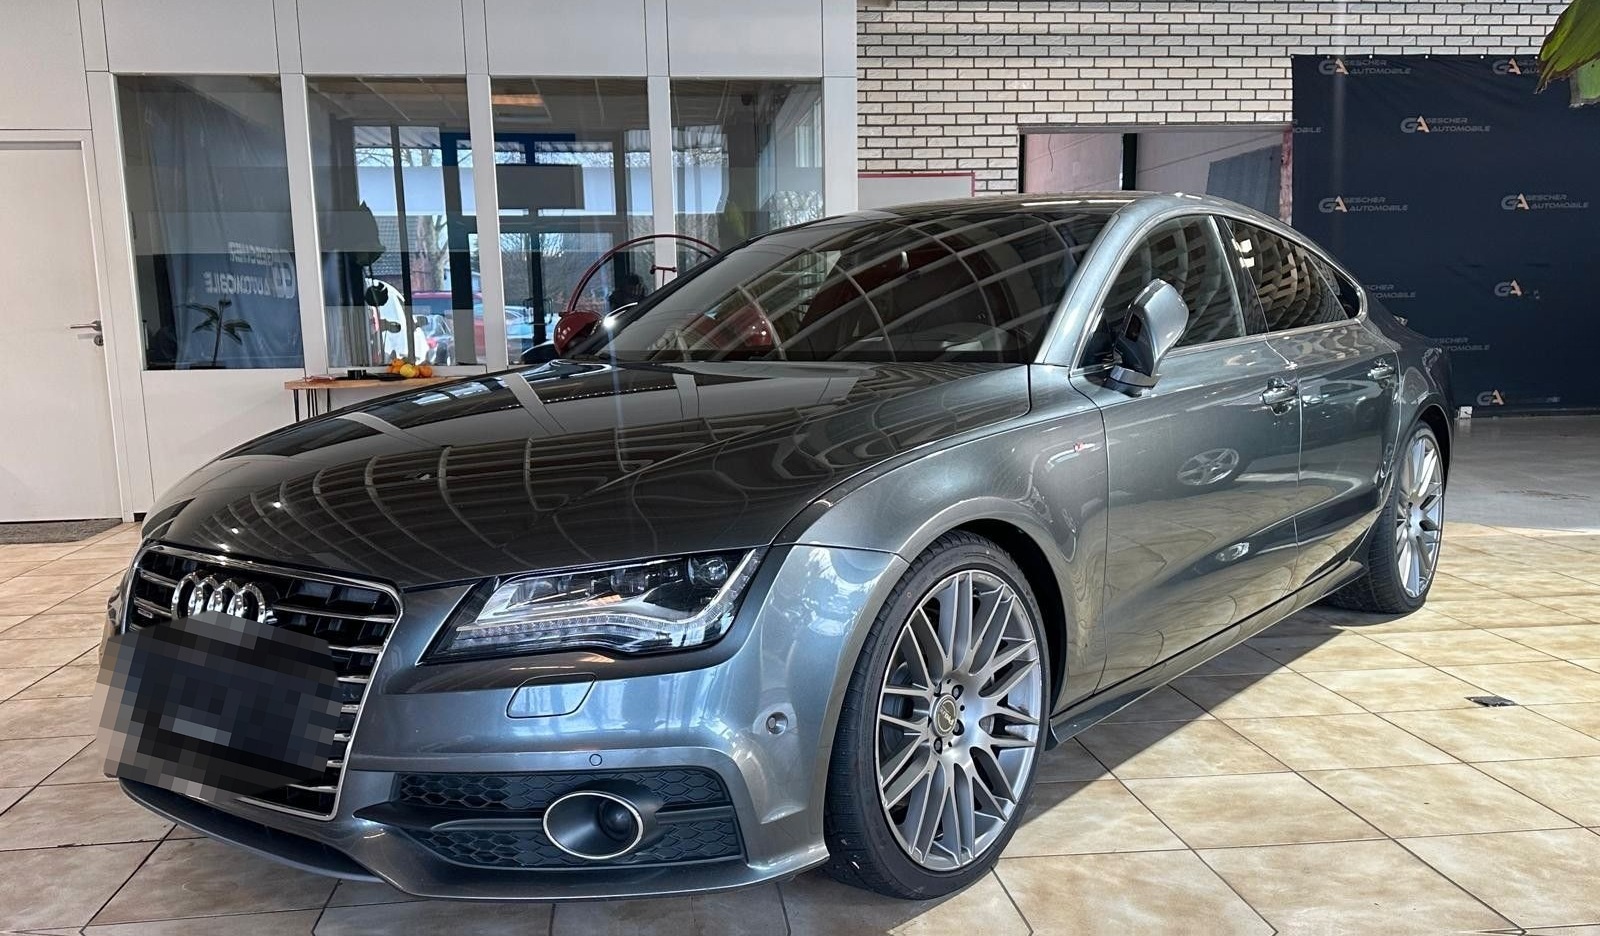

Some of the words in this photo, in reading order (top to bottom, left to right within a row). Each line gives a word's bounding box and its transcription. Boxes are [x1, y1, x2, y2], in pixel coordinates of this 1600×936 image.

[1318, 58, 1349, 75] GA
[1492, 58, 1521, 75] GA
[1400, 115, 1430, 133] GA
[1318, 195, 1348, 213] GA
[1349, 204, 1409, 212] AUTOMOBILE
[1501, 193, 1530, 210] GA
[1494, 280, 1522, 296] GA
[1477, 389, 1504, 406] GA
